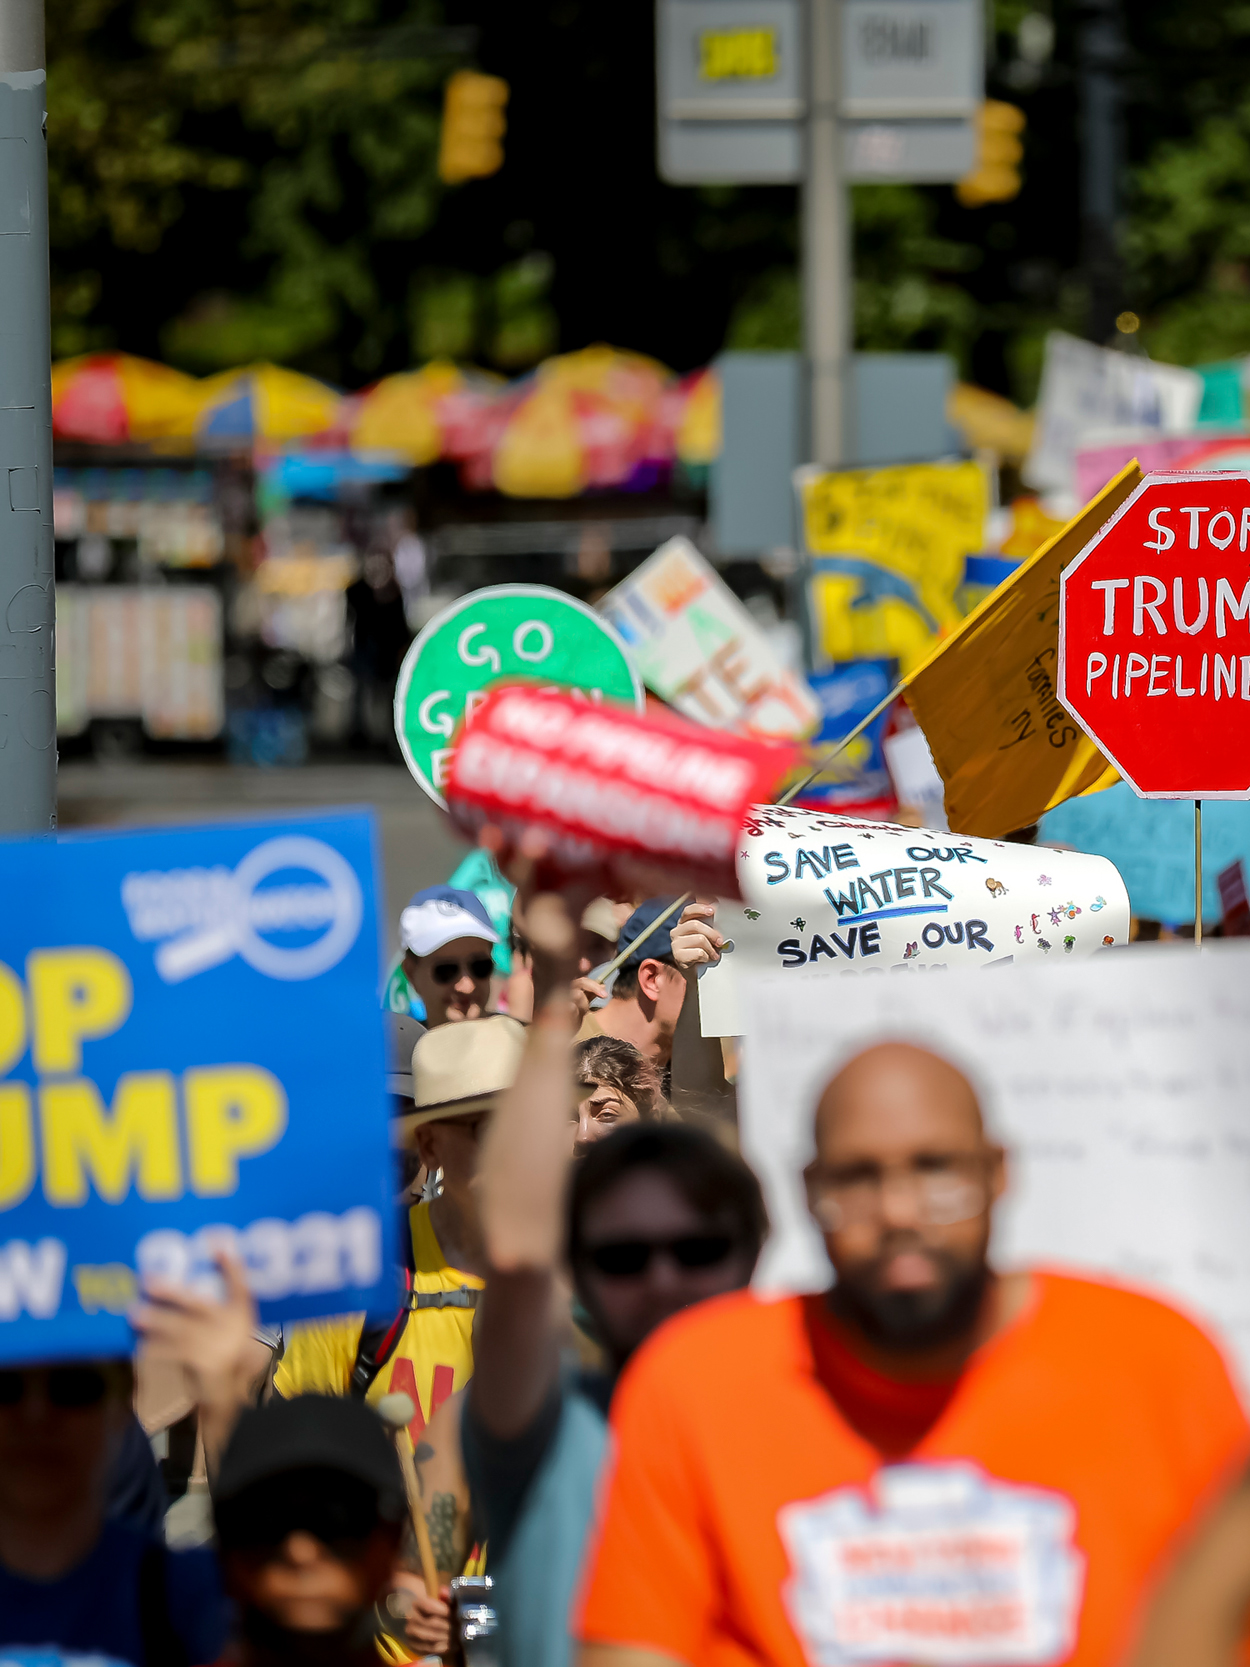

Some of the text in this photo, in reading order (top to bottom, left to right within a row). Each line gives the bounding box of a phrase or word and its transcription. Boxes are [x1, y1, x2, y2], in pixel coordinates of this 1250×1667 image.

[457, 620, 553, 673] GO
[764, 843, 988, 885] SAVE OUR
[823, 867, 954, 916] WATER
[777, 918, 995, 968] SAVE OUR
